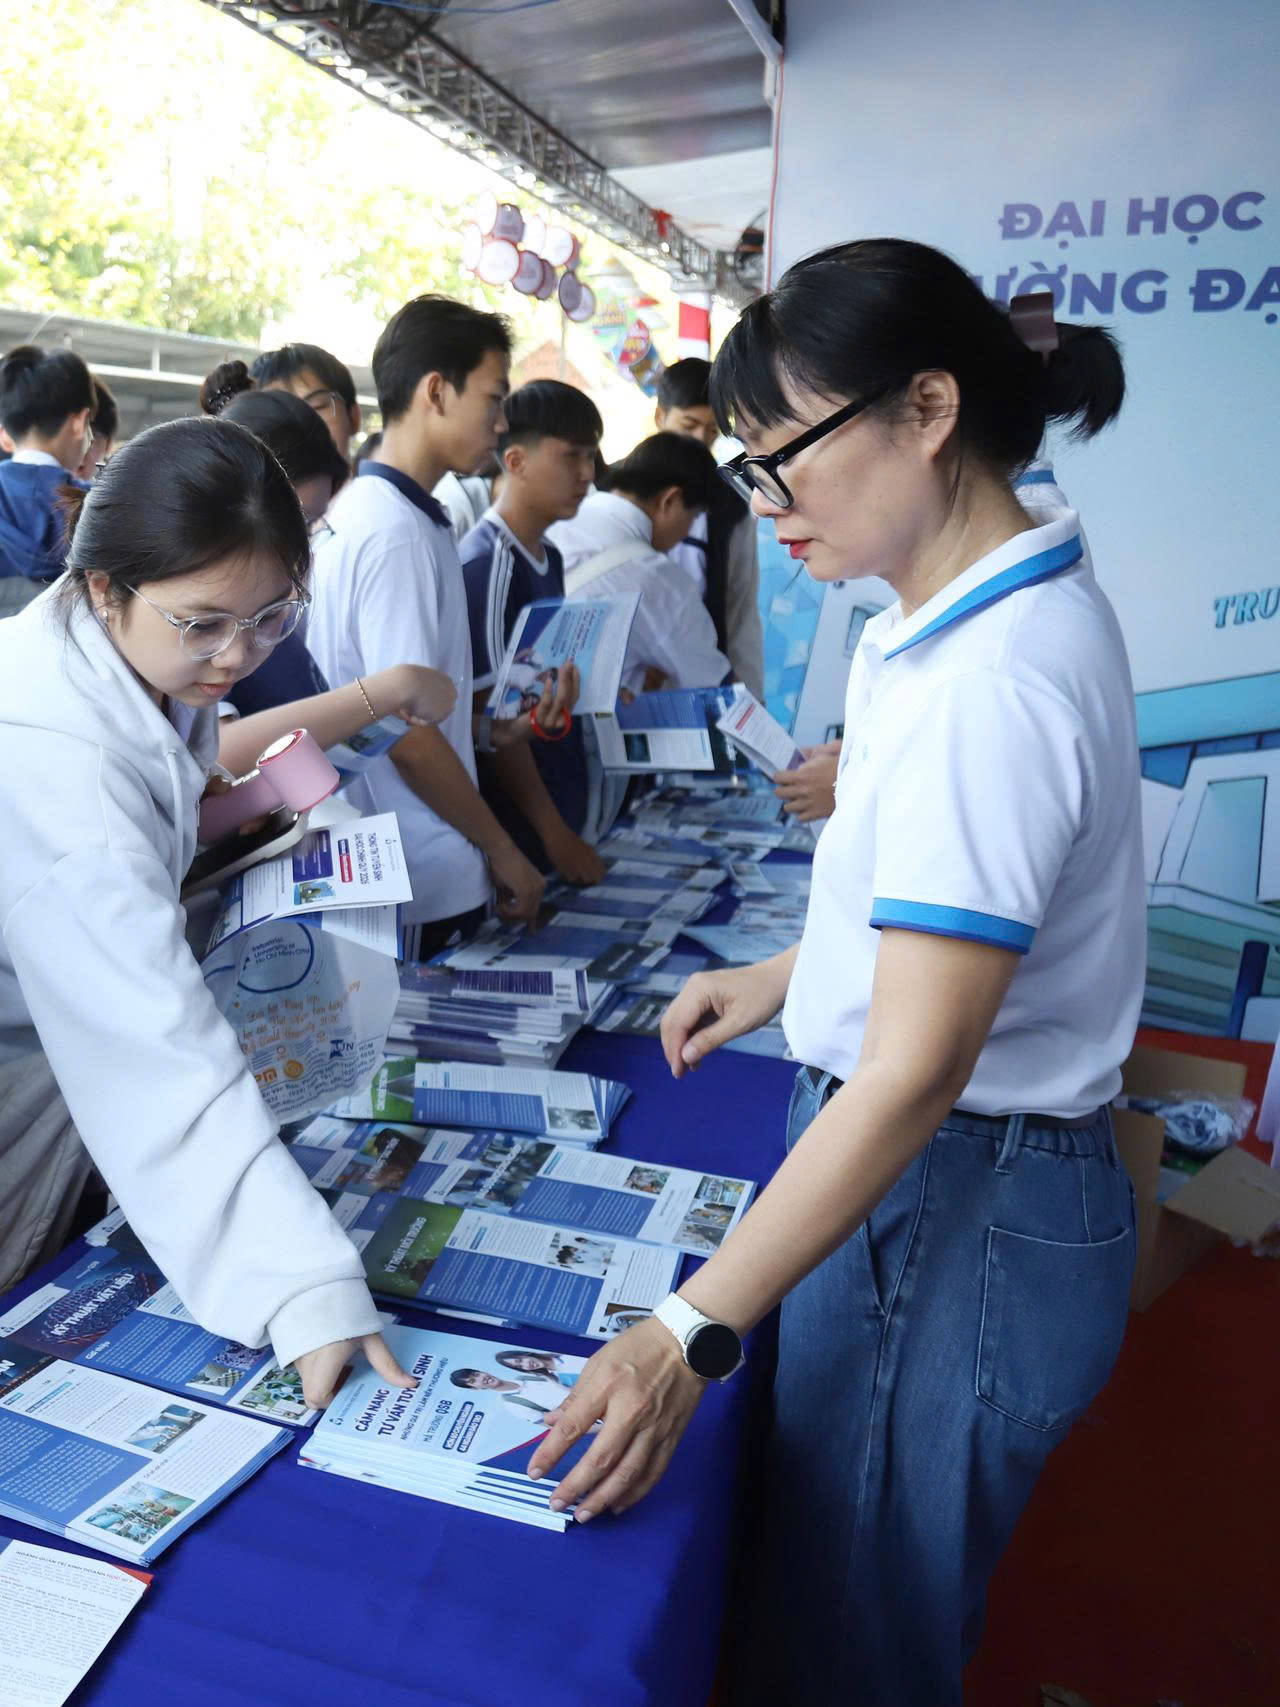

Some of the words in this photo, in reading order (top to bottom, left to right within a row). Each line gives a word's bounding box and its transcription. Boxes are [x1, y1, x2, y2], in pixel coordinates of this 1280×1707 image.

[998, 200, 1106, 249] ĐẠI
[1126, 191, 1266, 245] HỌC
[972, 261, 1169, 315] ƯỜNG
[50, 1321, 70, 1336] KỸ
[64, 1301, 99, 1326] THUẬT
[95, 1287, 118, 1304] VẬT
[110, 1272, 136, 1293] LIỆU
[412, 1354, 434, 1376] SINH
[367, 1389, 390, 1413] NANG
[396, 1376, 422, 1402] TUYN
[385, 1403, 407, 1422] VẤN
[435, 1400, 452, 1415] QSB
[377, 1421, 396, 1436] TƯ
